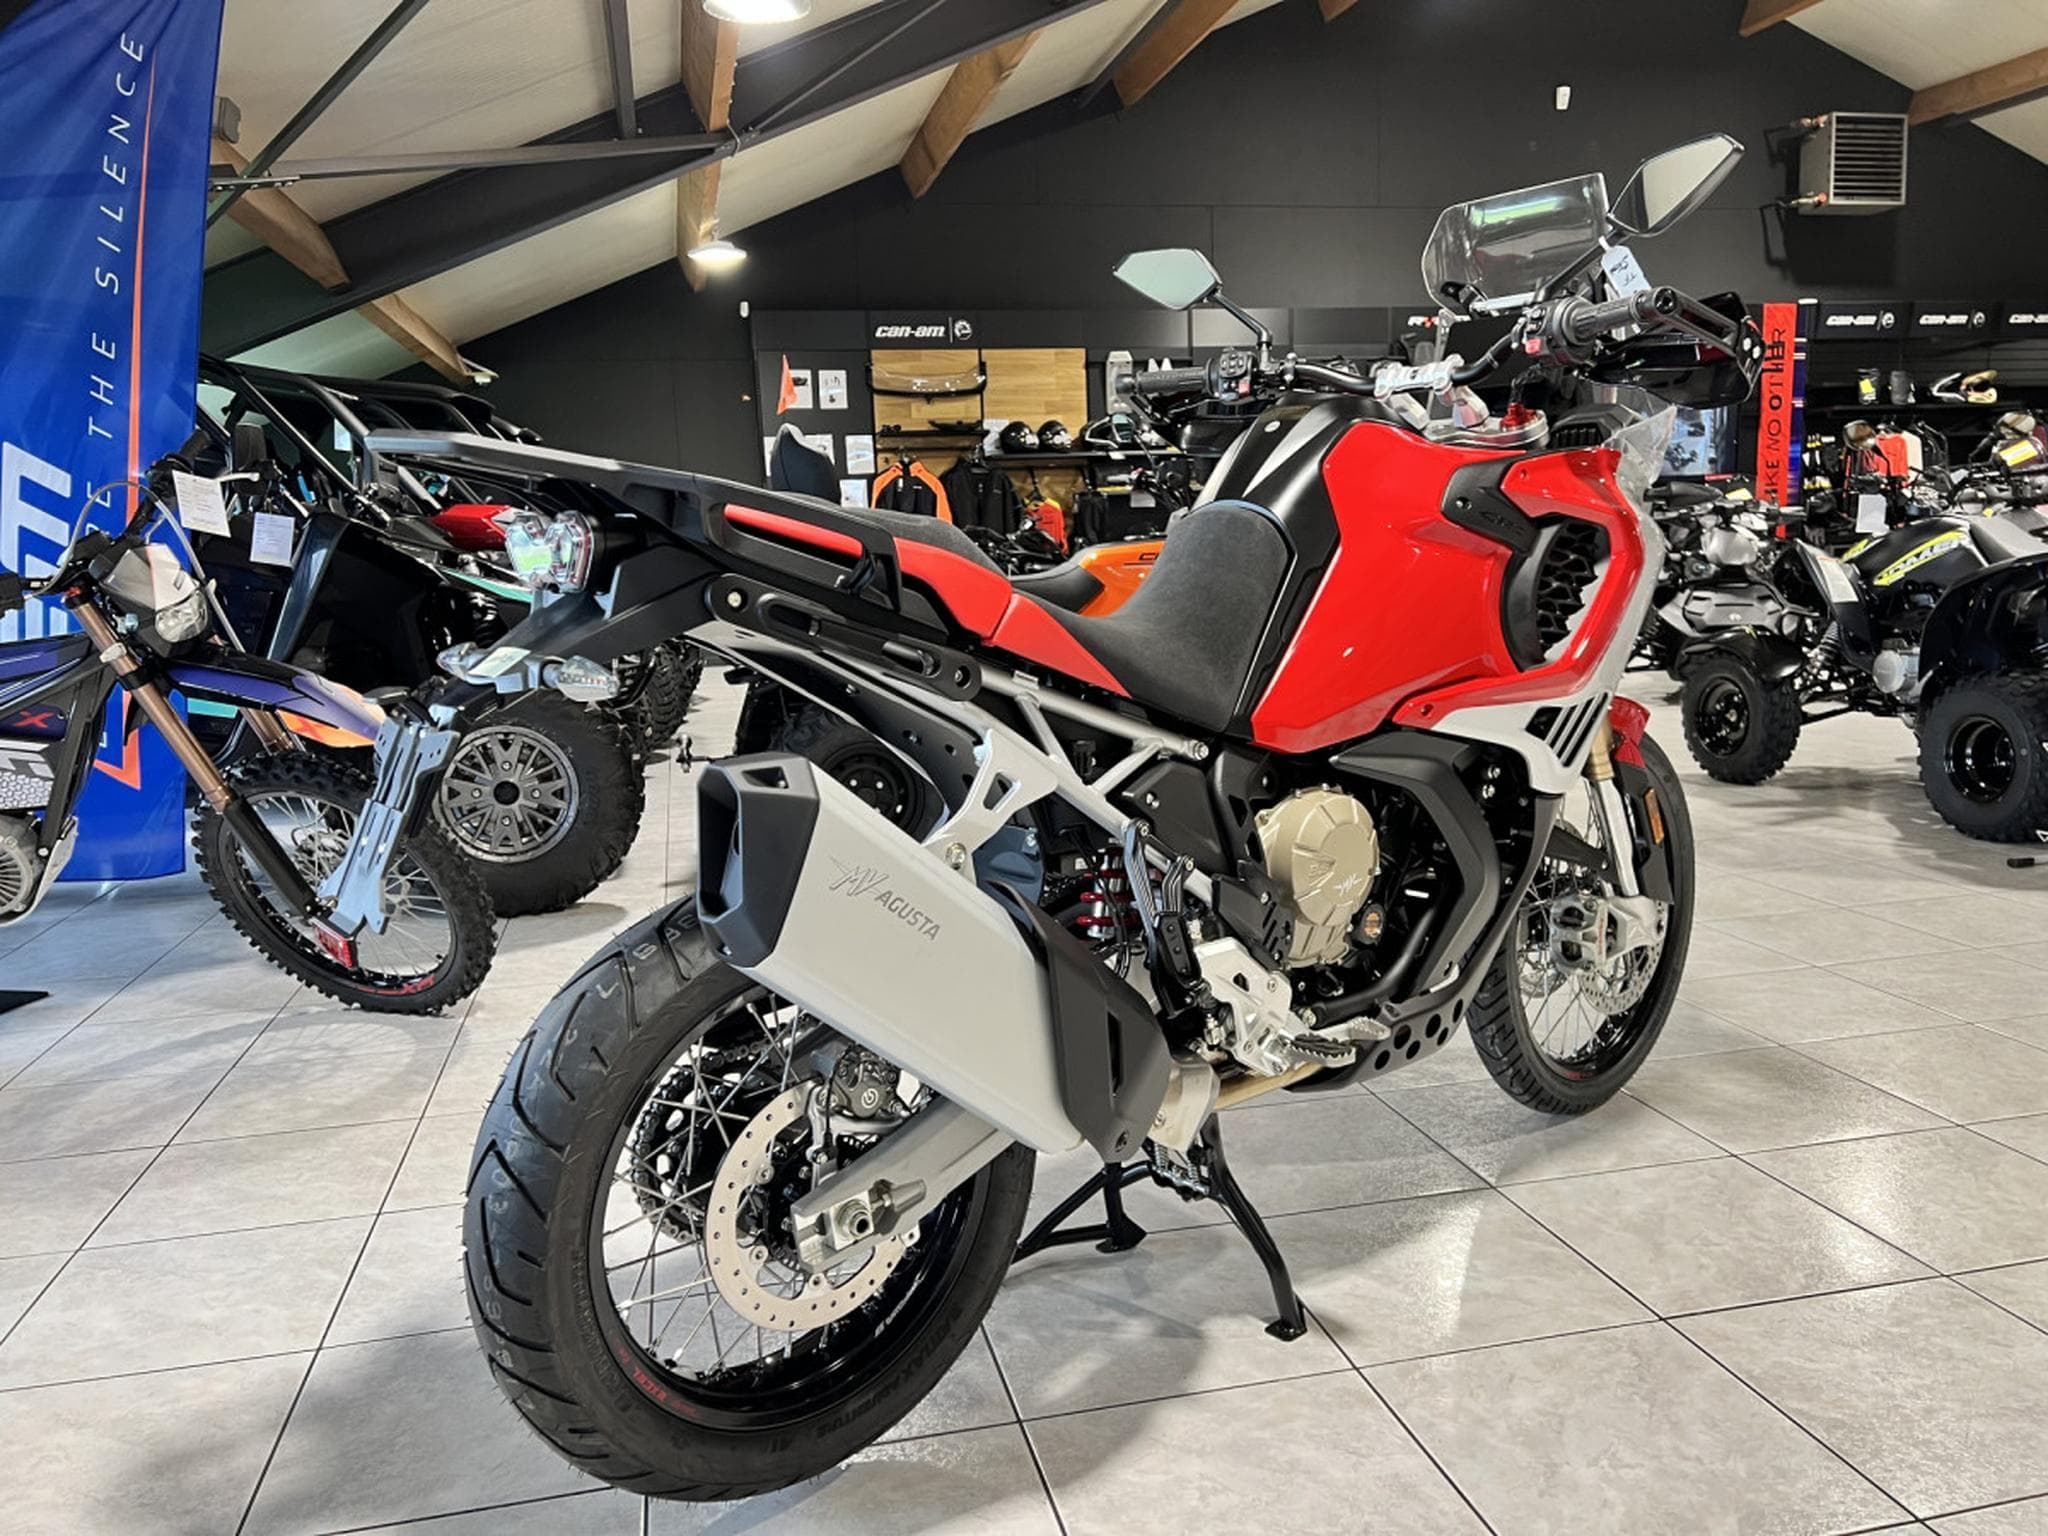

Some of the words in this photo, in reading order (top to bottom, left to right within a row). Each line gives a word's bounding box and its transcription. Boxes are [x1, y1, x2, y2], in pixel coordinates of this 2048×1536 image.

[95, 32, 145, 295] SILENCE
[875, 325, 946, 338] can-am
[88, 333, 117, 440] THE
[1768, 419, 1783, 451] NO
[1764, 460, 1781, 502] IKE
[874, 889, 941, 941] AGUSTA
